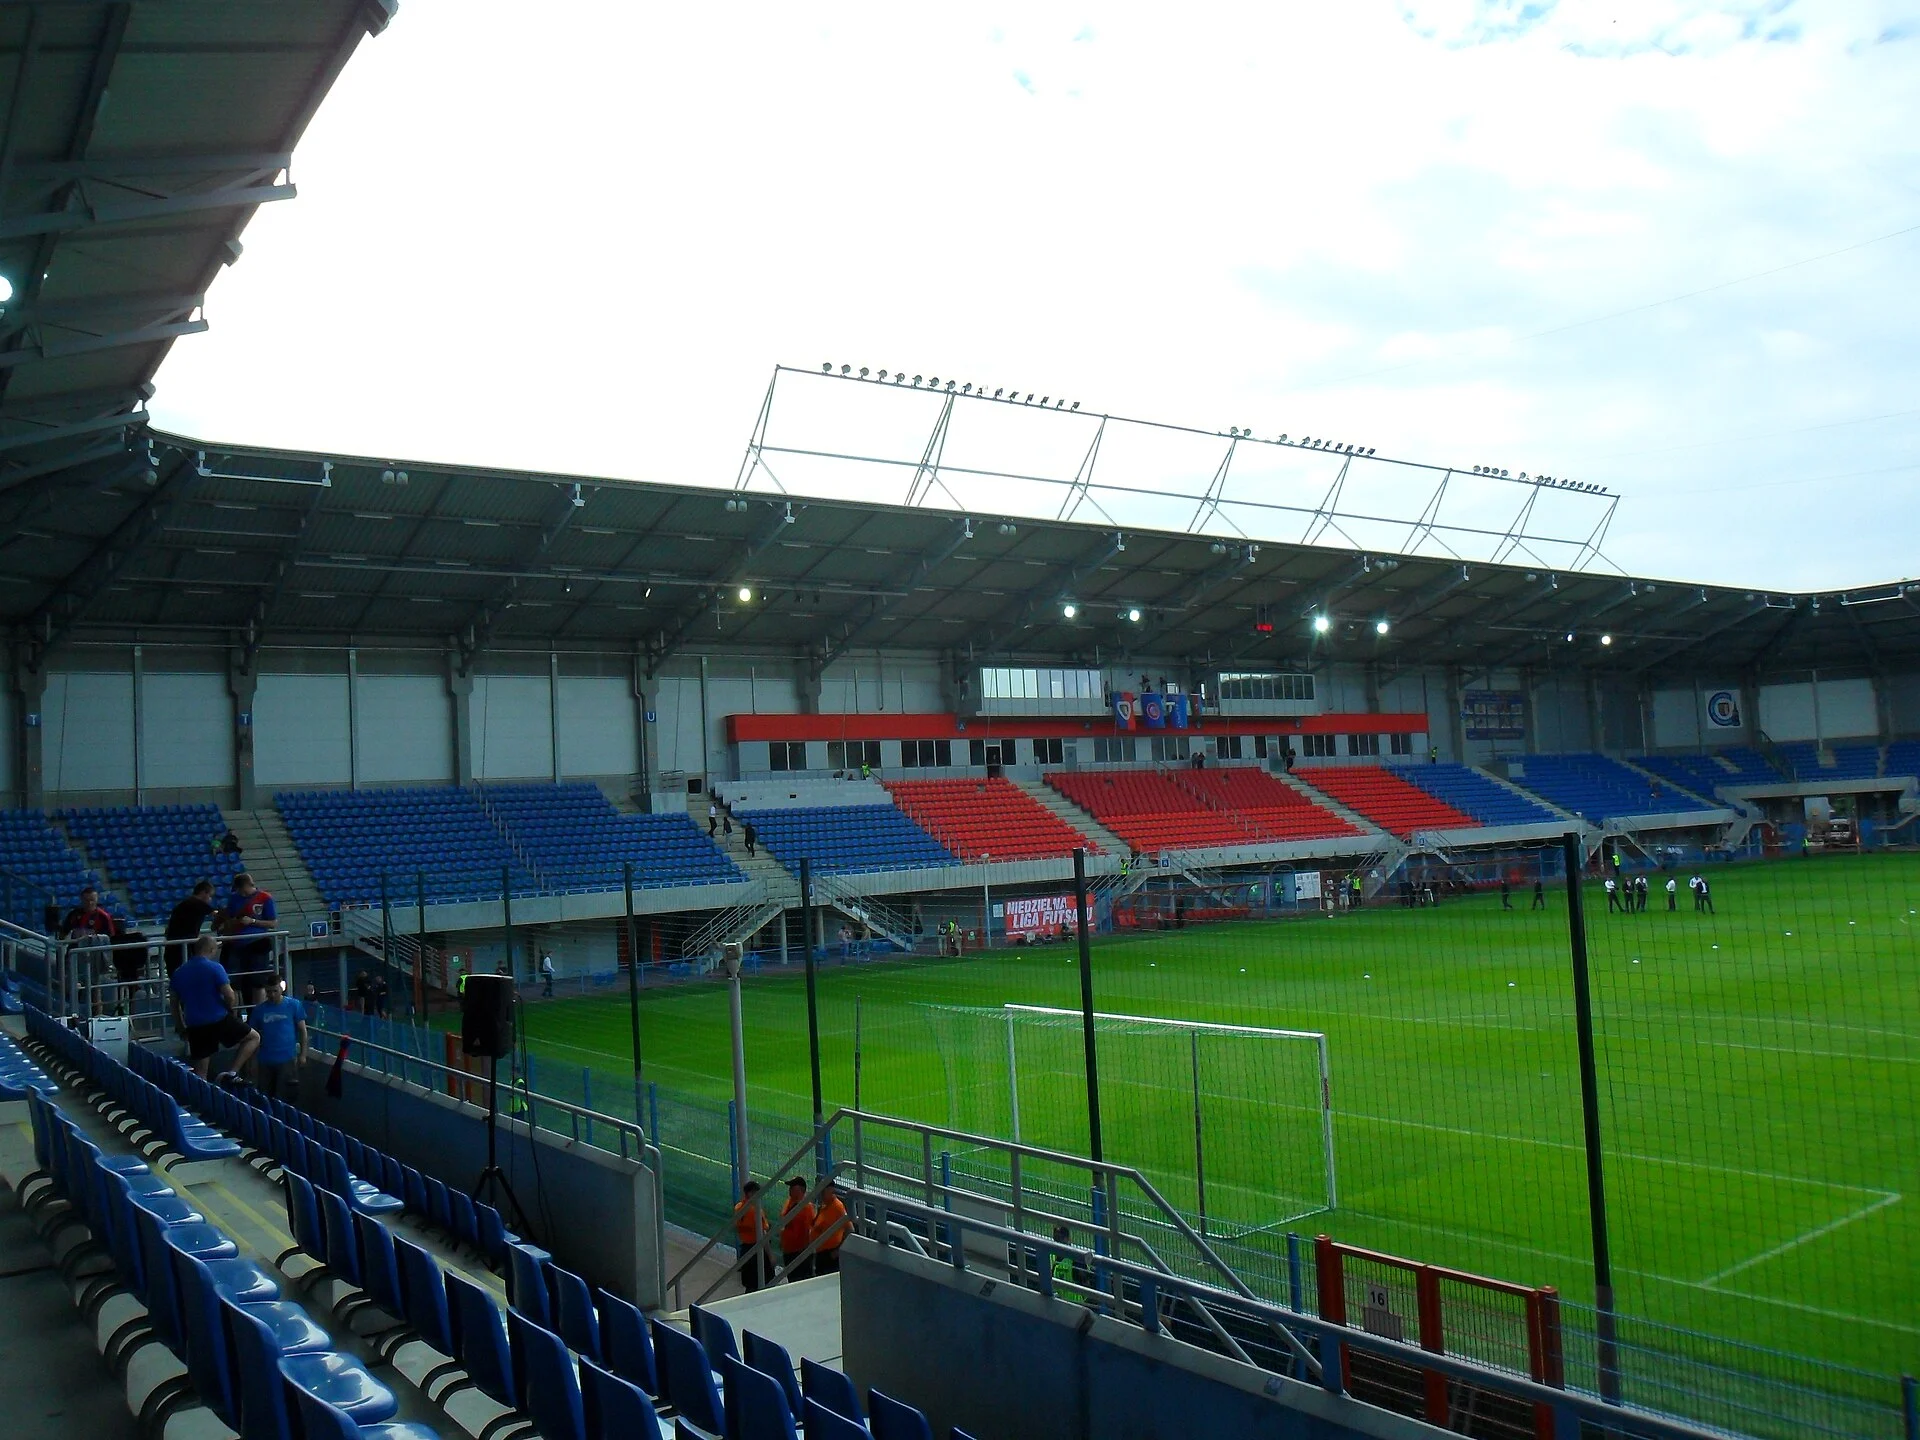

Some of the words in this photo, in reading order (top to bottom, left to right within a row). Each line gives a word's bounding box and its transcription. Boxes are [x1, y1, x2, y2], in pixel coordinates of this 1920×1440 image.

[29, 714, 37, 726] T
[241, 713, 249, 725] T
[647, 711, 655, 722] U
[1007, 897, 1067, 915] NIEDZIELNA
[1013, 912, 1040, 929] LIGA
[1043, 906, 1093, 926] FUTSAU
[1371, 1291, 1385, 1306] 16
